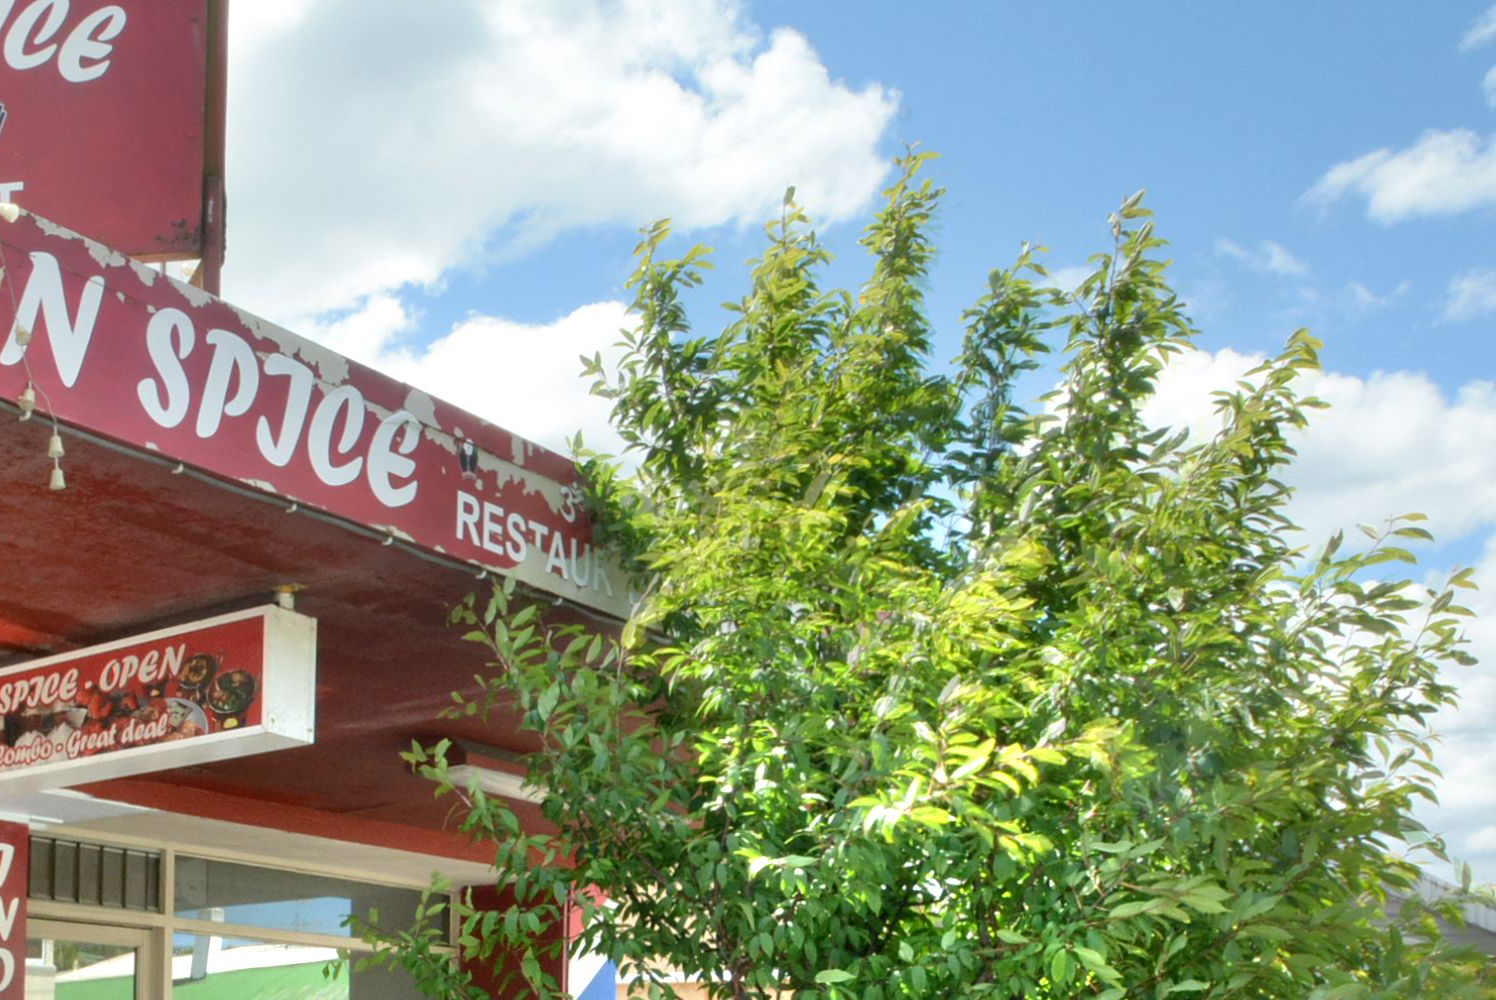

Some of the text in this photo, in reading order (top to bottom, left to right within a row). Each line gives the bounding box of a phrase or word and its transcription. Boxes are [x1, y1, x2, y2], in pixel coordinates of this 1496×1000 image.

[137, 306, 422, 507] SPICE
[456, 489, 614, 598] RESTAUR
[98, 643, 186, 692] OPEN
[66, 726, 115, 758] Great
[120, 713, 167, 743] deal
